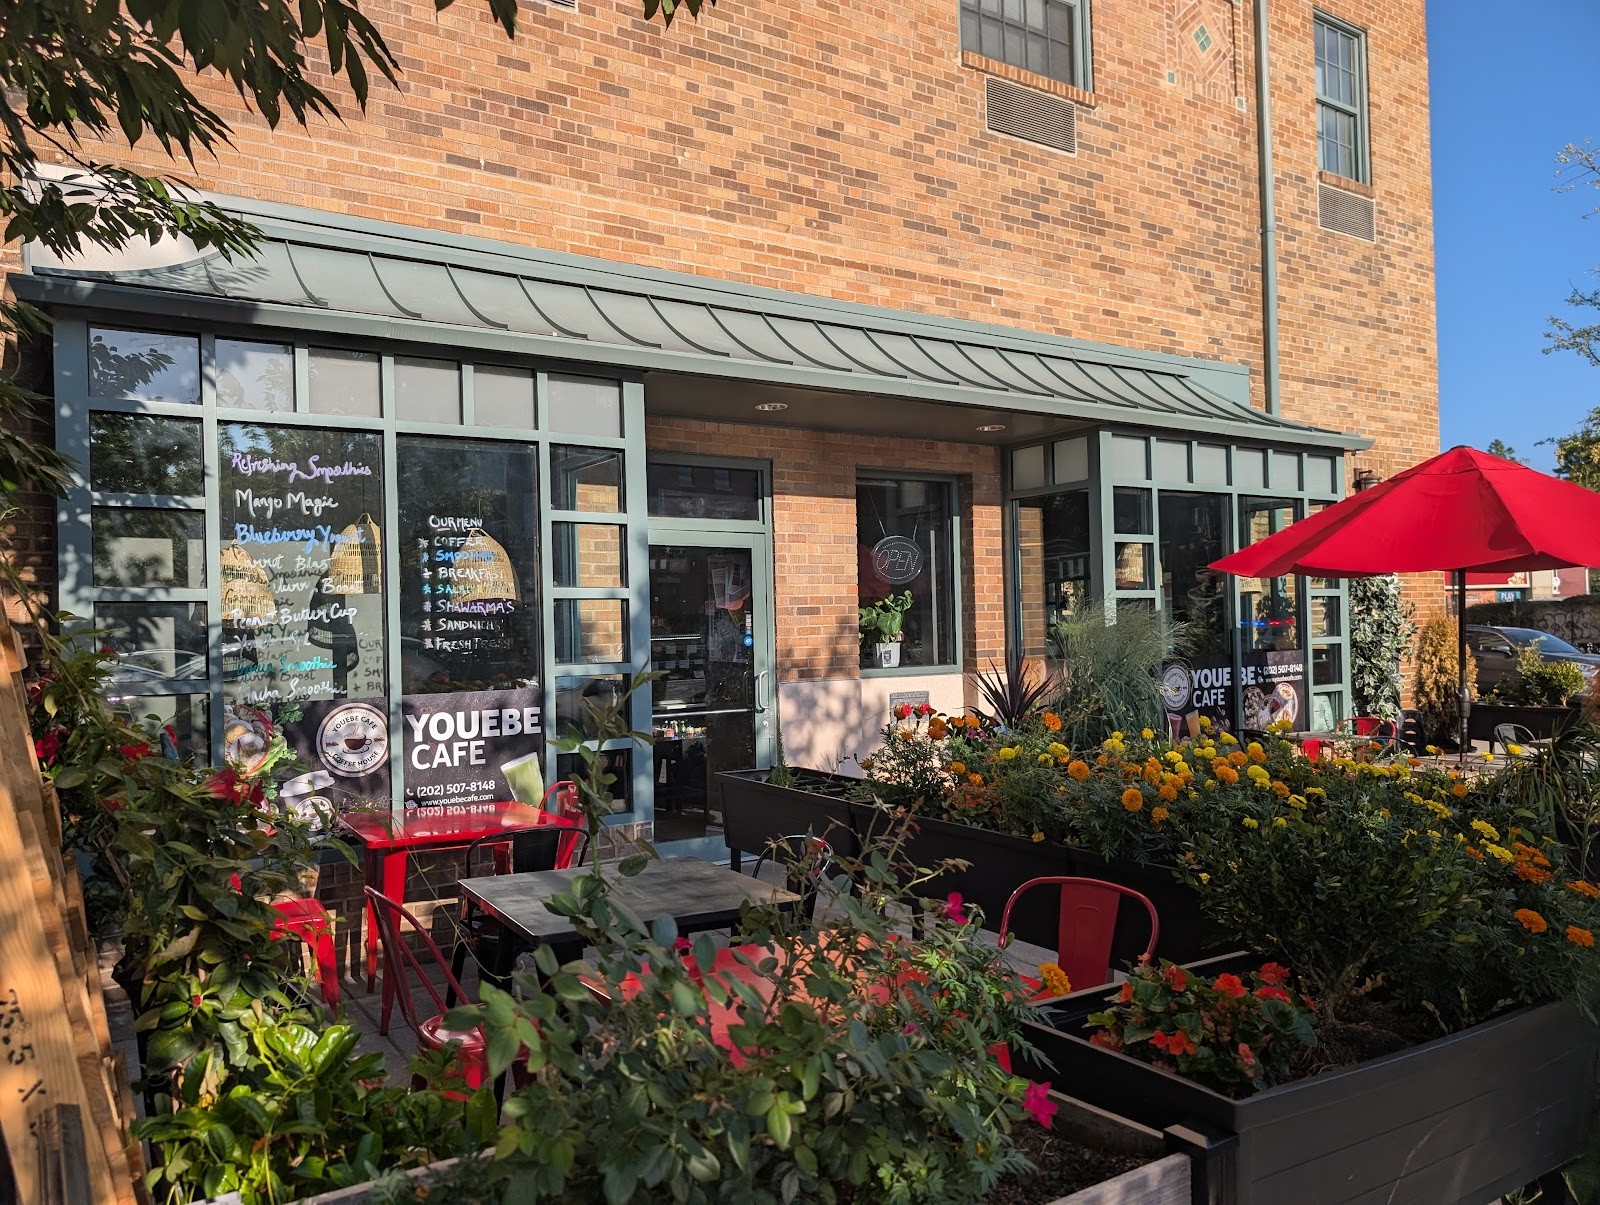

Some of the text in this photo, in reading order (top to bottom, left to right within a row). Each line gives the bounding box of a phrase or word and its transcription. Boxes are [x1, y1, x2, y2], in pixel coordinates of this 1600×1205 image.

[235, 488, 339, 518] Mango Magic
[428, 514, 483, 532] OUR MENU
[234, 522, 319, 554] Blueberry
[434, 536, 485, 547] COFFEE
[877, 549, 919, 571] OPEN
[1500, 592, 1515, 601] PLAY
[331, 602, 358, 625] Cup
[435, 637, 471, 652] FRESH
[1278, 663, 1303, 674] 507-8148
[1192, 689, 1226, 708] CAFE
[332, 715, 378, 732] YOUEBE CAFE
[405, 706, 542, 742] YOUEBE
[358, 751, 379, 766] HOUSE
[411, 740, 486, 770] CAFE
[416, 780, 496, 798] (202) 507-8148
[421, 793, 494, 807] www.youebecafe.com
